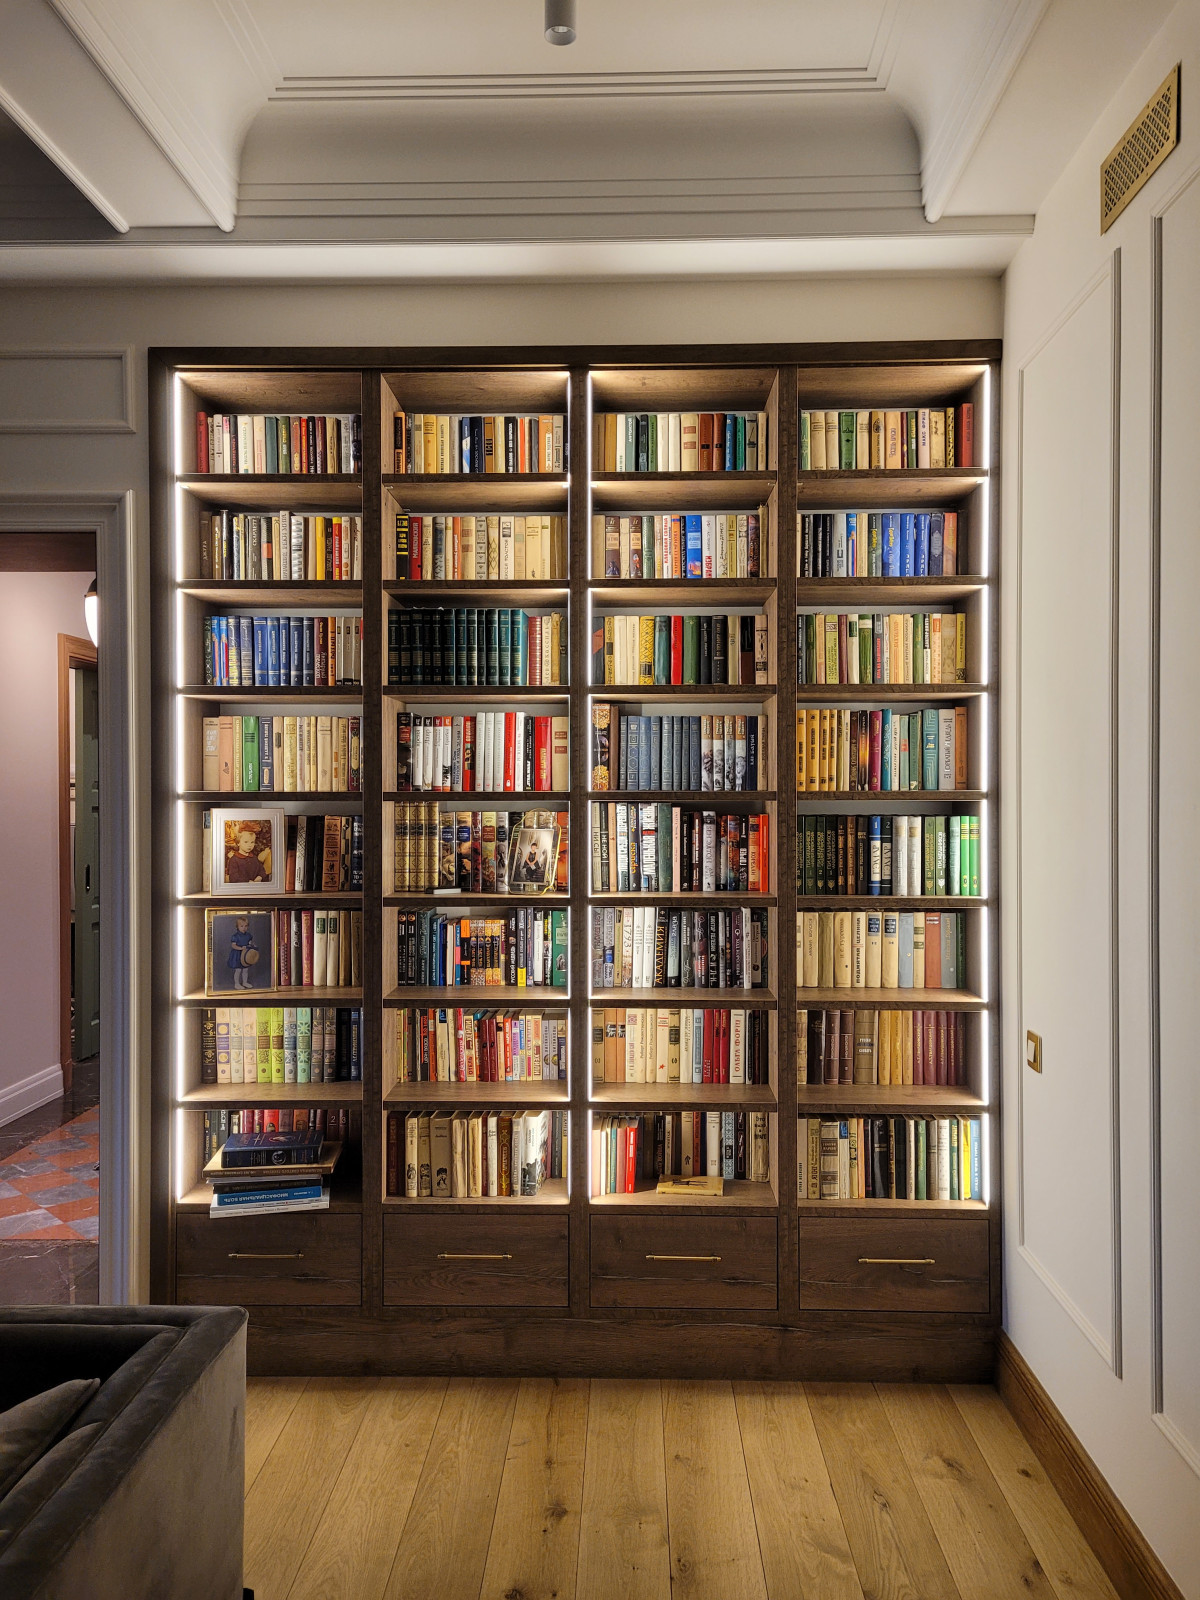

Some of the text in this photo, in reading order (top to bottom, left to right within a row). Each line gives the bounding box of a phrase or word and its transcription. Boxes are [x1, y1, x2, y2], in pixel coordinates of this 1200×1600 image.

[643, 806, 656, 875] МАЛЕНЬКАЯ ЖИЗНЬ
[655, 926, 664, 984] АКАДЕМИЯ
